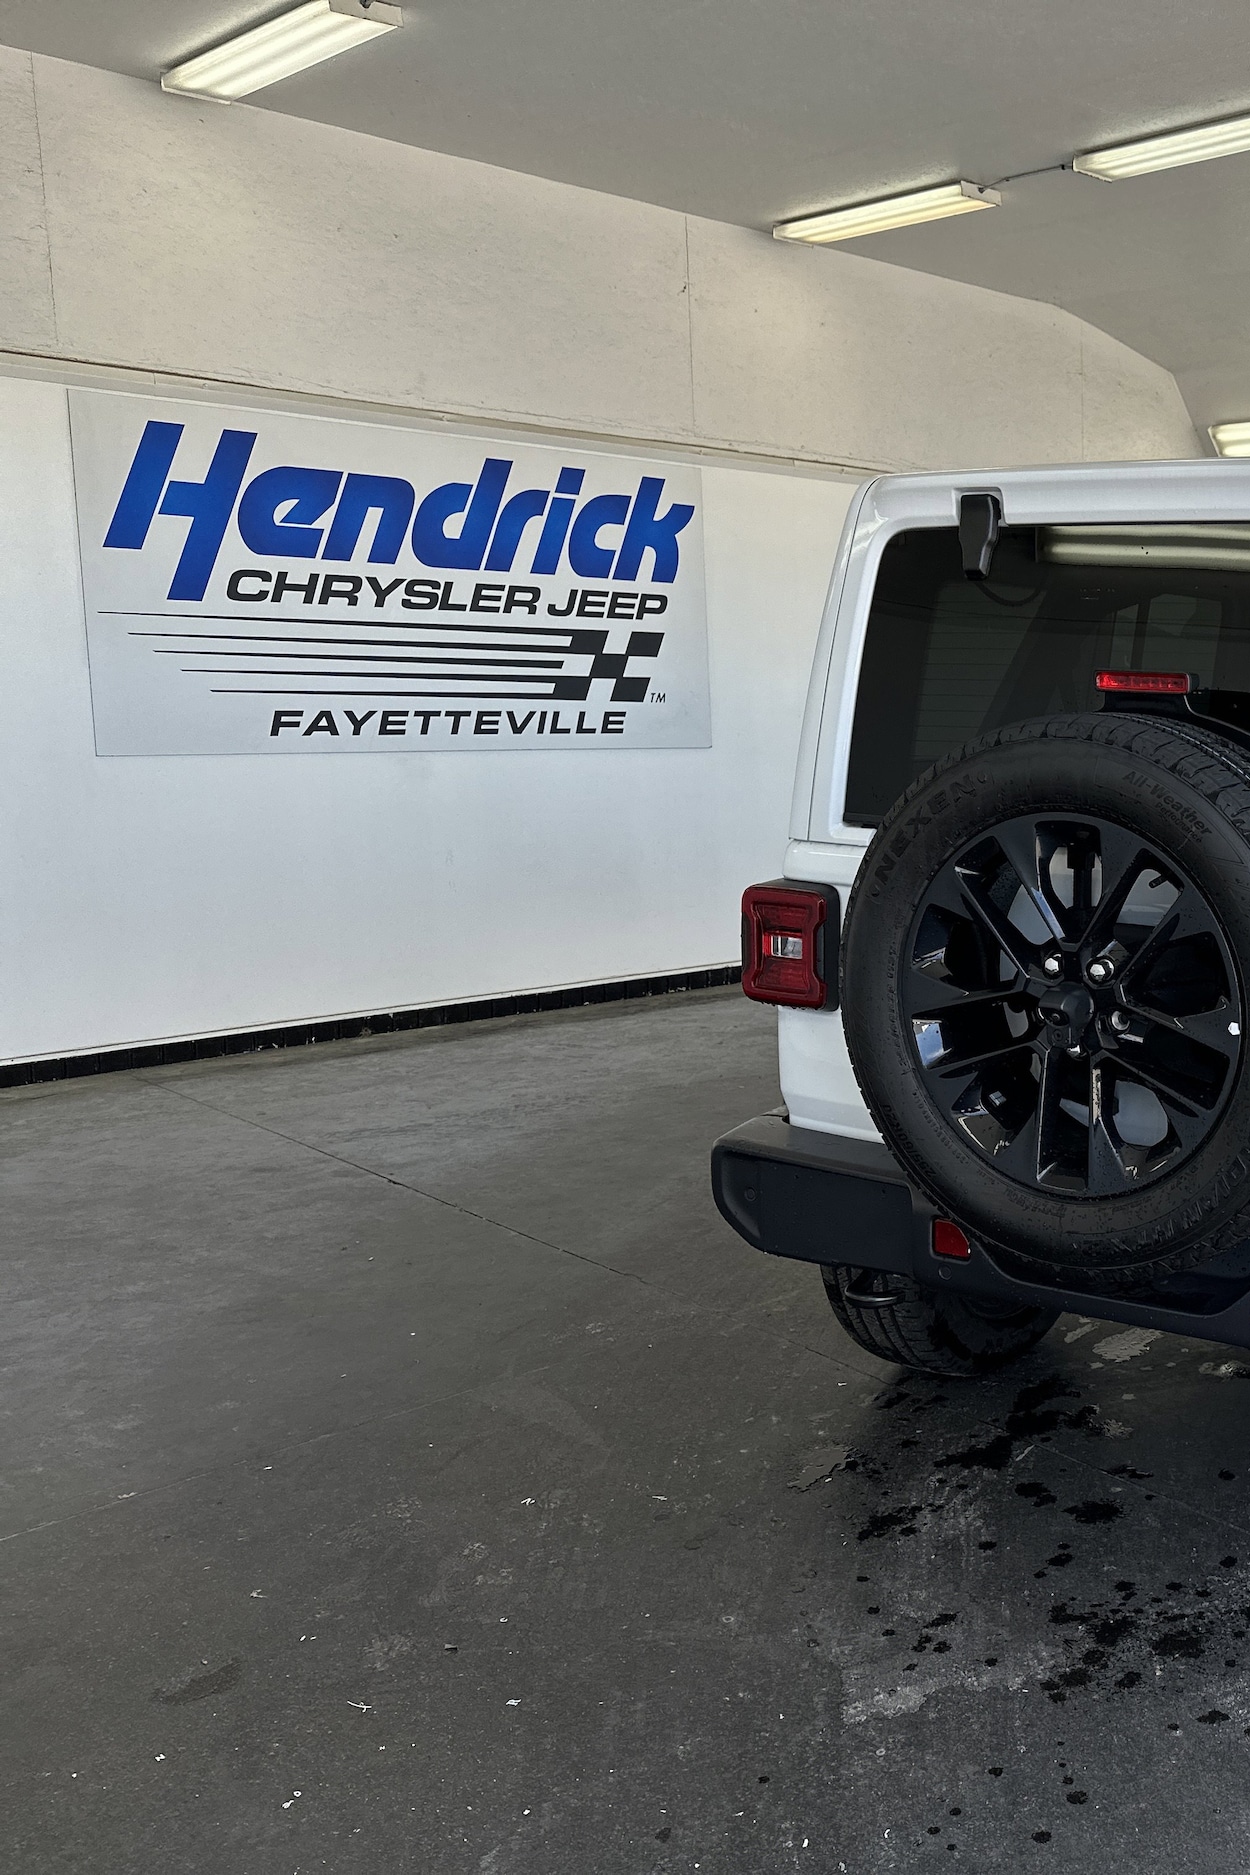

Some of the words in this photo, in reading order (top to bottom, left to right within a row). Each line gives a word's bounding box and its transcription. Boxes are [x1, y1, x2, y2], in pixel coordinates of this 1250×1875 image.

[103, 420, 694, 602] Hendrick
[226, 569, 544, 615] CHRYSLER
[547, 589, 668, 621] JEEP
[270, 710, 626, 737] FAYETTEVILLE
[650, 692, 666, 703] TM
[875, 774, 977, 886] NEXEN
[1122, 770, 1212, 836] All-Weather
